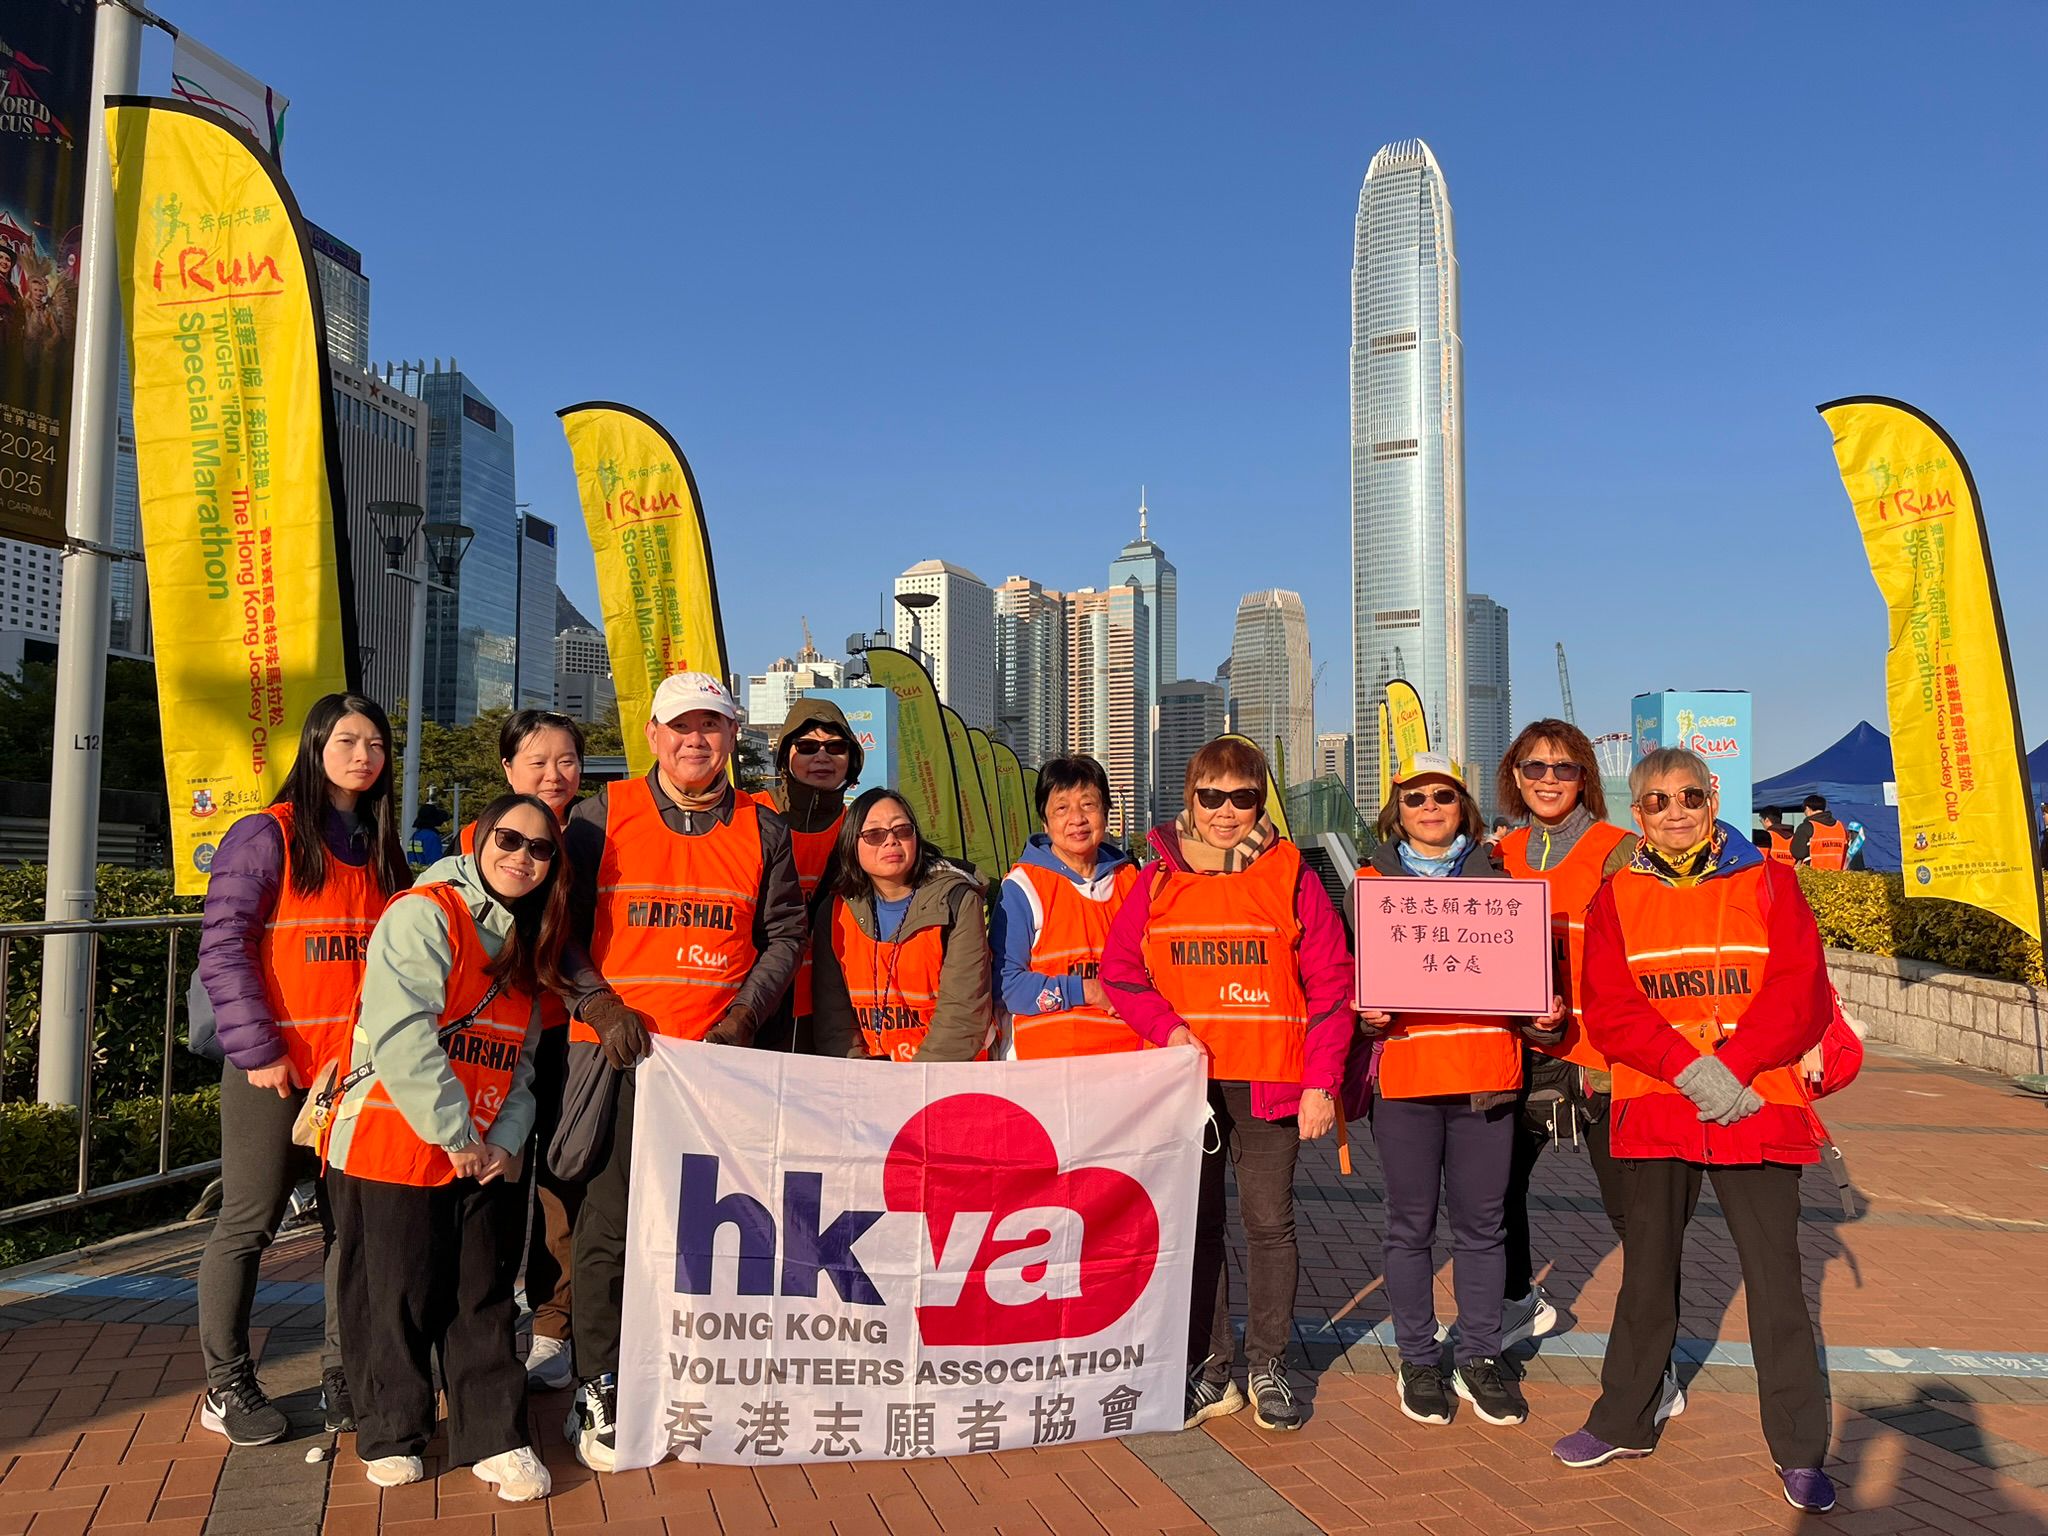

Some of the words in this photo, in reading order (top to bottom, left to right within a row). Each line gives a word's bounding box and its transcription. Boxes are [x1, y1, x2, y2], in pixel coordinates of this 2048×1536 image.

[200, 206, 271, 232] 奔向共融
[211, 308, 235, 390] TWGHs
[173, 312, 218, 431] Special
[7, 499, 55, 520] CARNIVAL
[192, 439, 232, 600] Marathon
[232, 485, 249, 525] The
[236, 530, 255, 585] Hong
[621, 529, 651, 602] Special
[640, 526, 658, 577] TWGHs
[243, 590, 261, 646] Kong
[1910, 611, 1935, 713] Marathon
[248, 650, 265, 722] Jockey
[75, 734, 99, 750] L12
[1937, 704, 1947, 741] Kong
[251, 727, 268, 774] Club
[1940, 743, 1953, 789] Jockey
[1945, 791, 1961, 822] Club
[628, 902, 733, 930] MARSHAL
[1378, 896, 1523, 917] 香港志願者協會
[1170, 941, 1269, 965] MARSHAL
[1391, 924, 1449, 943] 賽事組
[1457, 928, 1514, 944] Zone3
[1422, 954, 1482, 974] 集合處
[1639, 968, 1751, 999] MARSHAL
[672, 1310, 773, 1341] HONG
[786, 1313, 888, 1345] KONG
[669, 1351, 904, 1386] VOLUNTEERS
[915, 1343, 1145, 1386] ASSOCIATION
[664, 1384, 1142, 1458] 香港志願者協會
